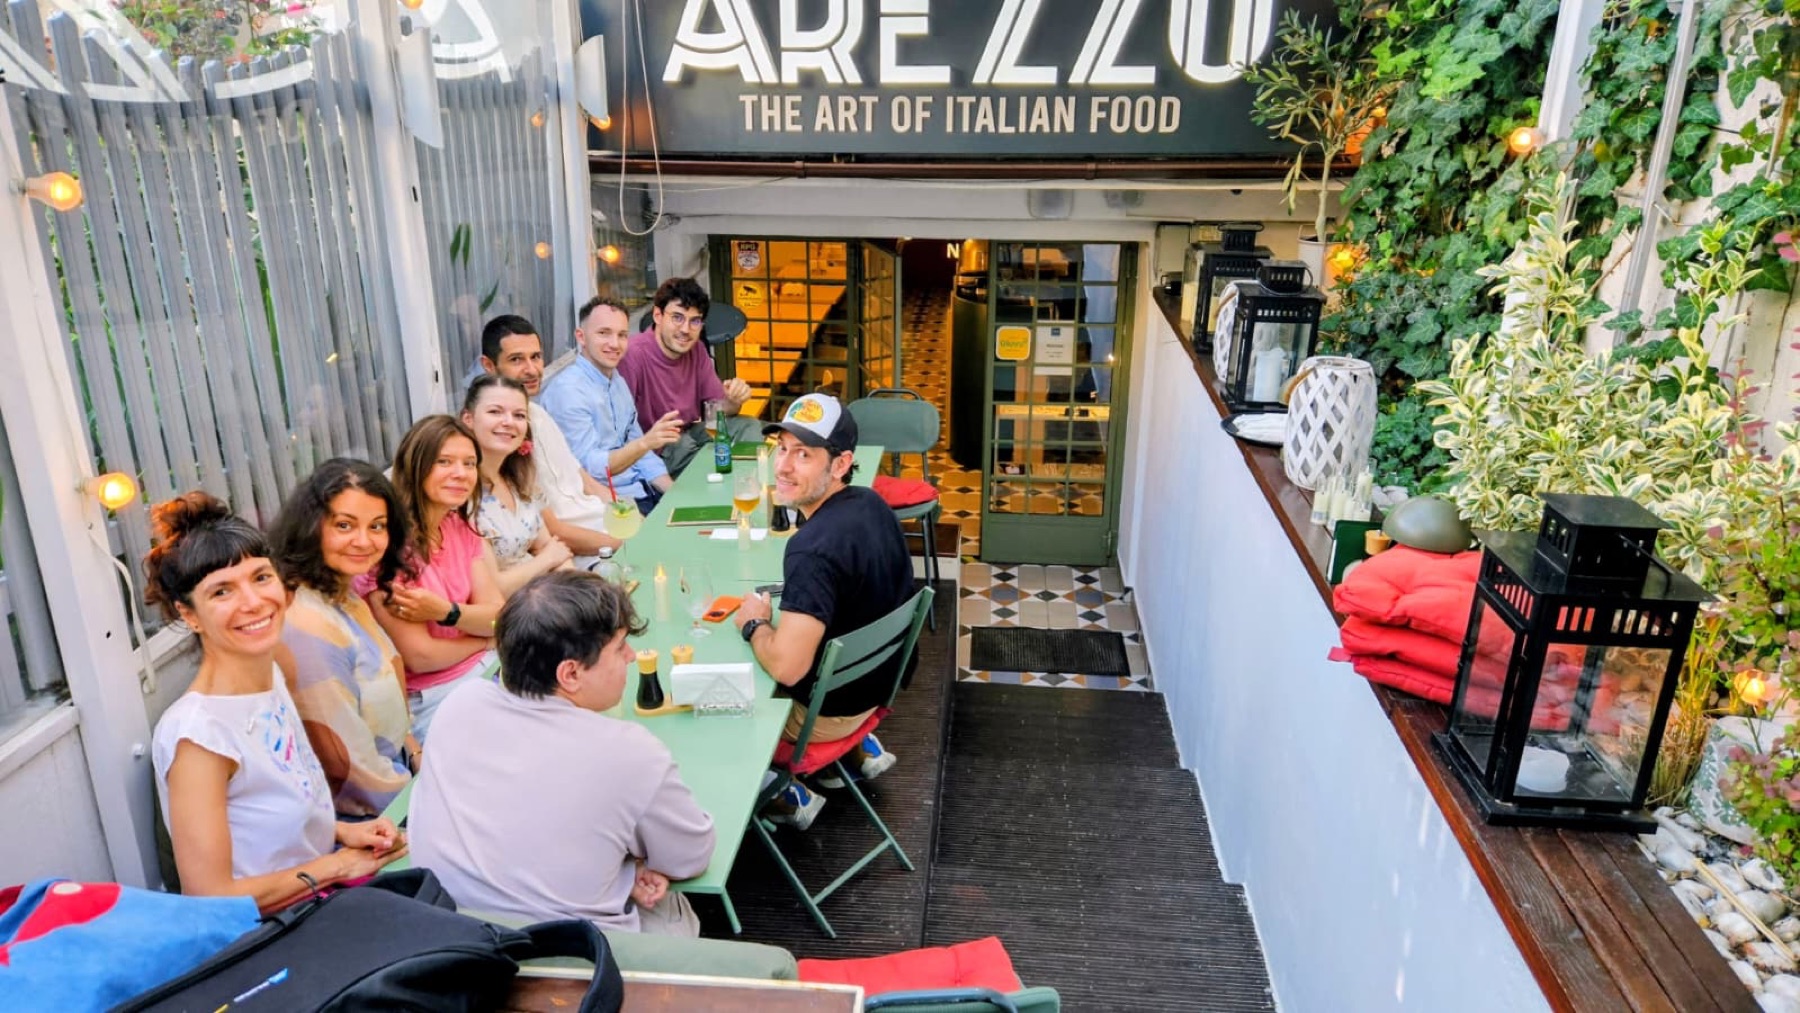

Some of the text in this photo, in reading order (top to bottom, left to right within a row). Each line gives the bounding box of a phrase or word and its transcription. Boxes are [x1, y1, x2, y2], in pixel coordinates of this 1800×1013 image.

[662, 0, 1273, 84] AREZZO
[739, 95, 1181, 134] THE ART OF ITALIAN FOOD
